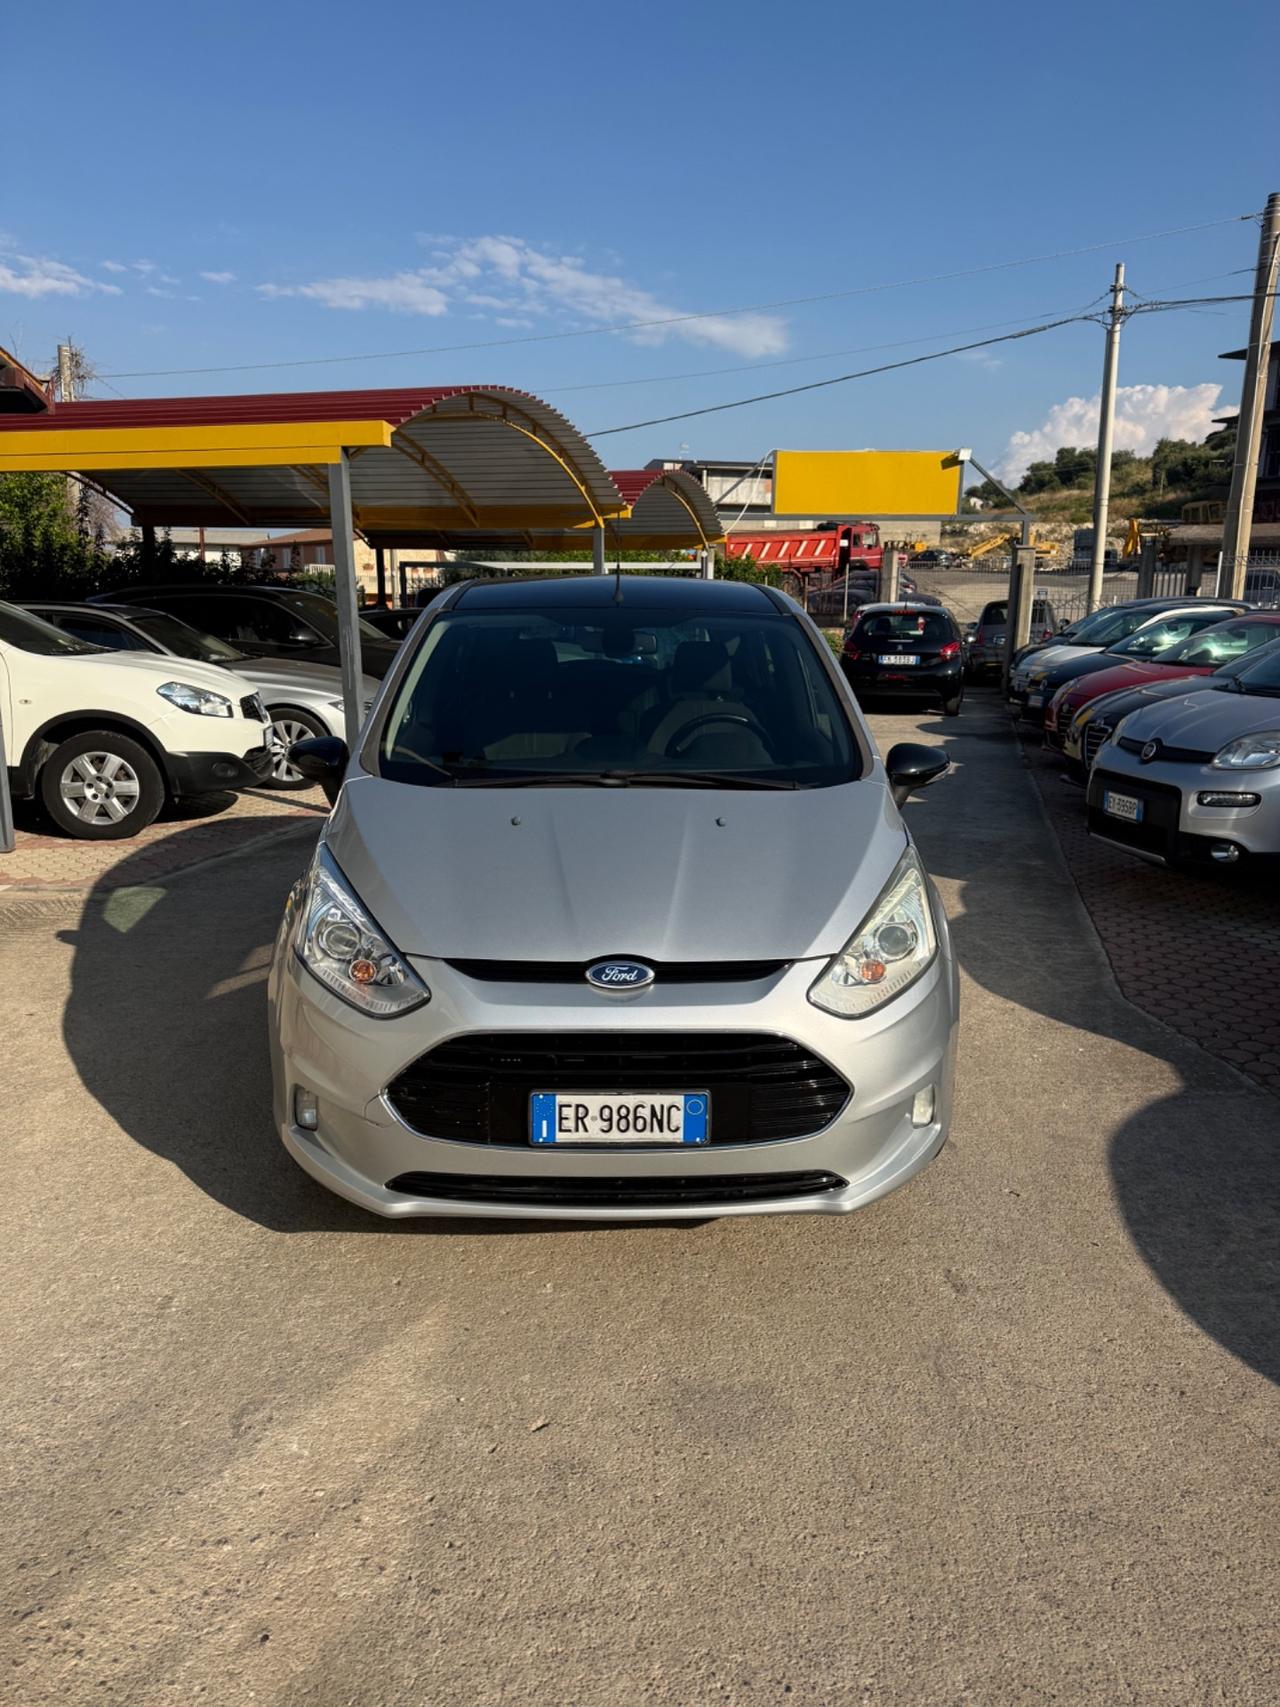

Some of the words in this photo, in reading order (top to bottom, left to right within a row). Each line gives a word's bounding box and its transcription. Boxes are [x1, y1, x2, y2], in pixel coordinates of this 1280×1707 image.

[601, 966, 638, 981] Ford
[557, 1103, 589, 1133] ER
[599, 1103, 681, 1134] 986NC
